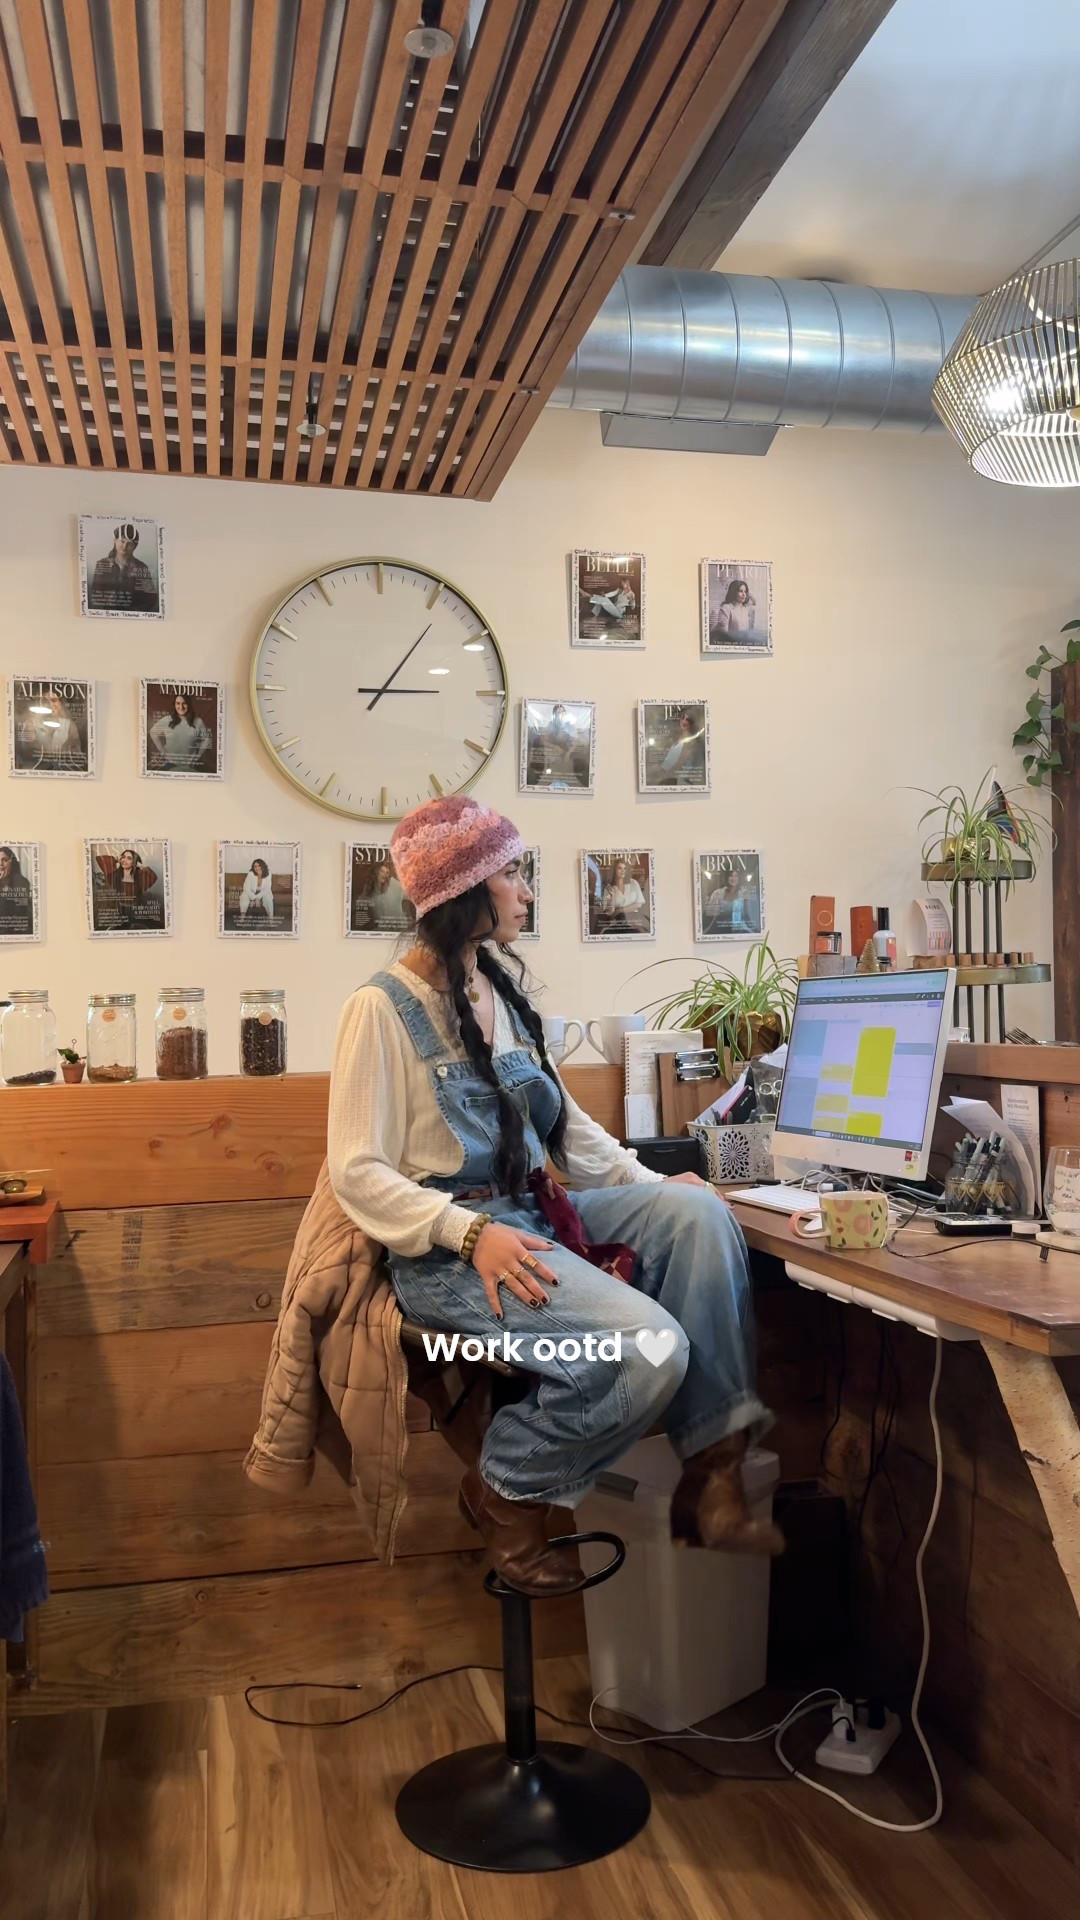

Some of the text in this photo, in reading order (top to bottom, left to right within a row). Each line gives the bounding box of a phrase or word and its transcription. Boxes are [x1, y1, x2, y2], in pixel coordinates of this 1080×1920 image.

[586, 557, 635, 573] BELLE
[17, 682, 87, 700] ALLISON
[159, 684, 207, 697] MADDIE
[355, 848, 390, 863] SYD
[706, 855, 747, 871] BRYN
